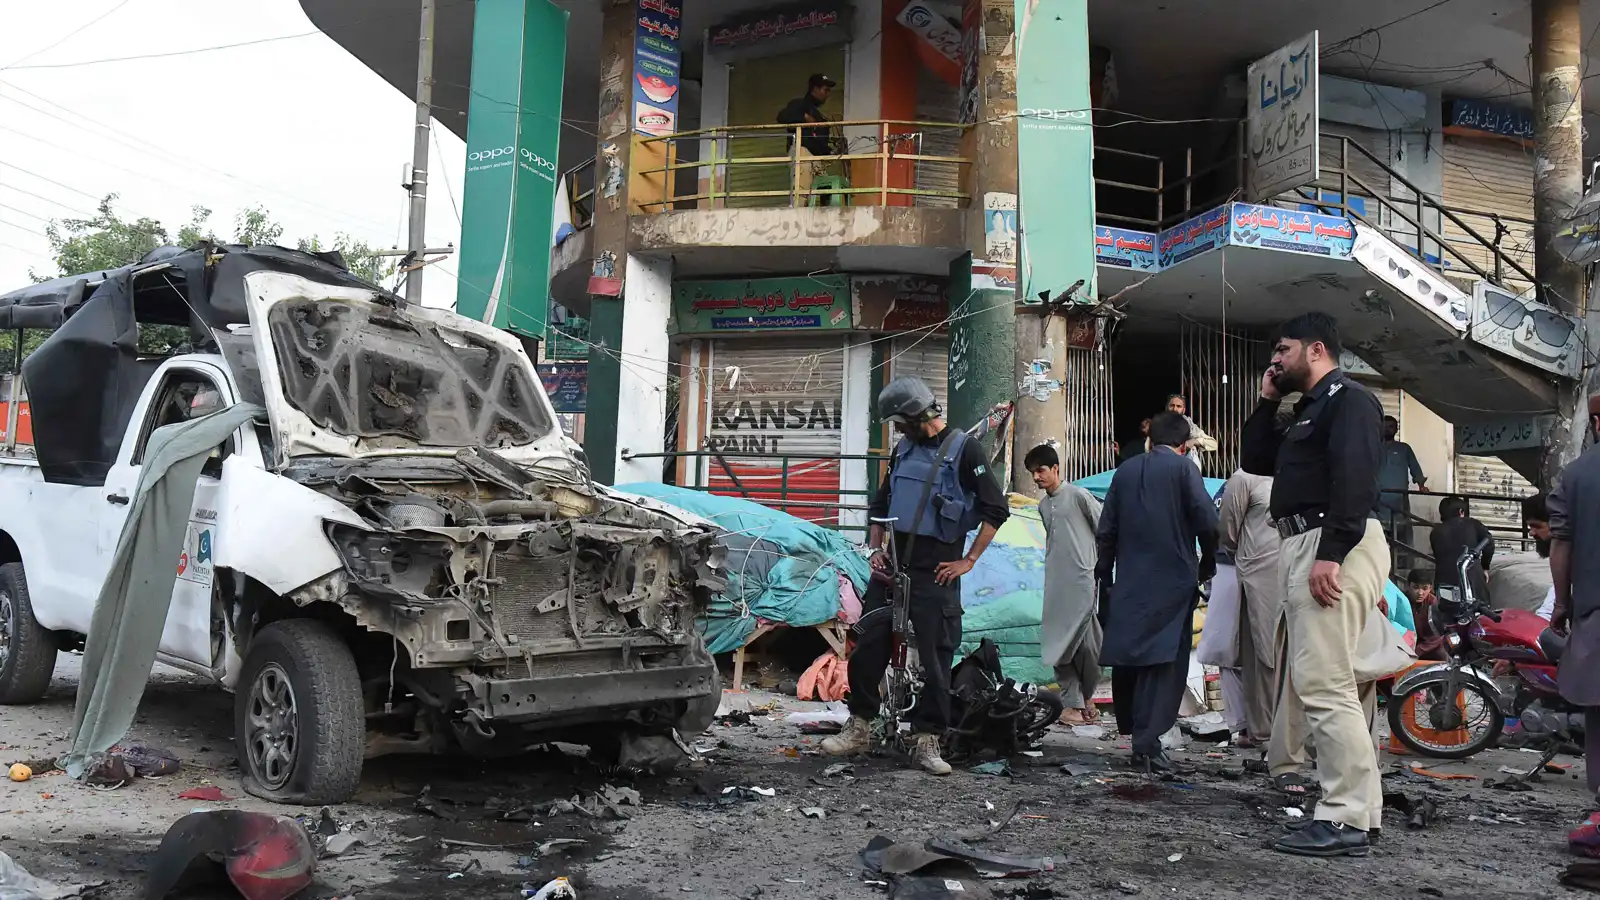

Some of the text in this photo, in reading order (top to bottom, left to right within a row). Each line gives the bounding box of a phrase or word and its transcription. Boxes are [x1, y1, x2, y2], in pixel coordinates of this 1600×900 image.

[1021, 108, 1086, 120] oppo
[468, 146, 514, 161] oppo
[520, 148, 555, 171] oppo
[1280, 214, 1311, 235] شوز
[1314, 221, 1352, 240] نعیم
[1115, 236, 1152, 253] نعیم
[741, 282, 786, 315] دوپٹہ
[788, 287, 835, 313] جمیل
[711, 400, 842, 430] KANSAI
[1476, 424, 1506, 447] موبائل
[1508, 423, 1531, 443] خالد
[710, 434, 784, 454] PAINT
